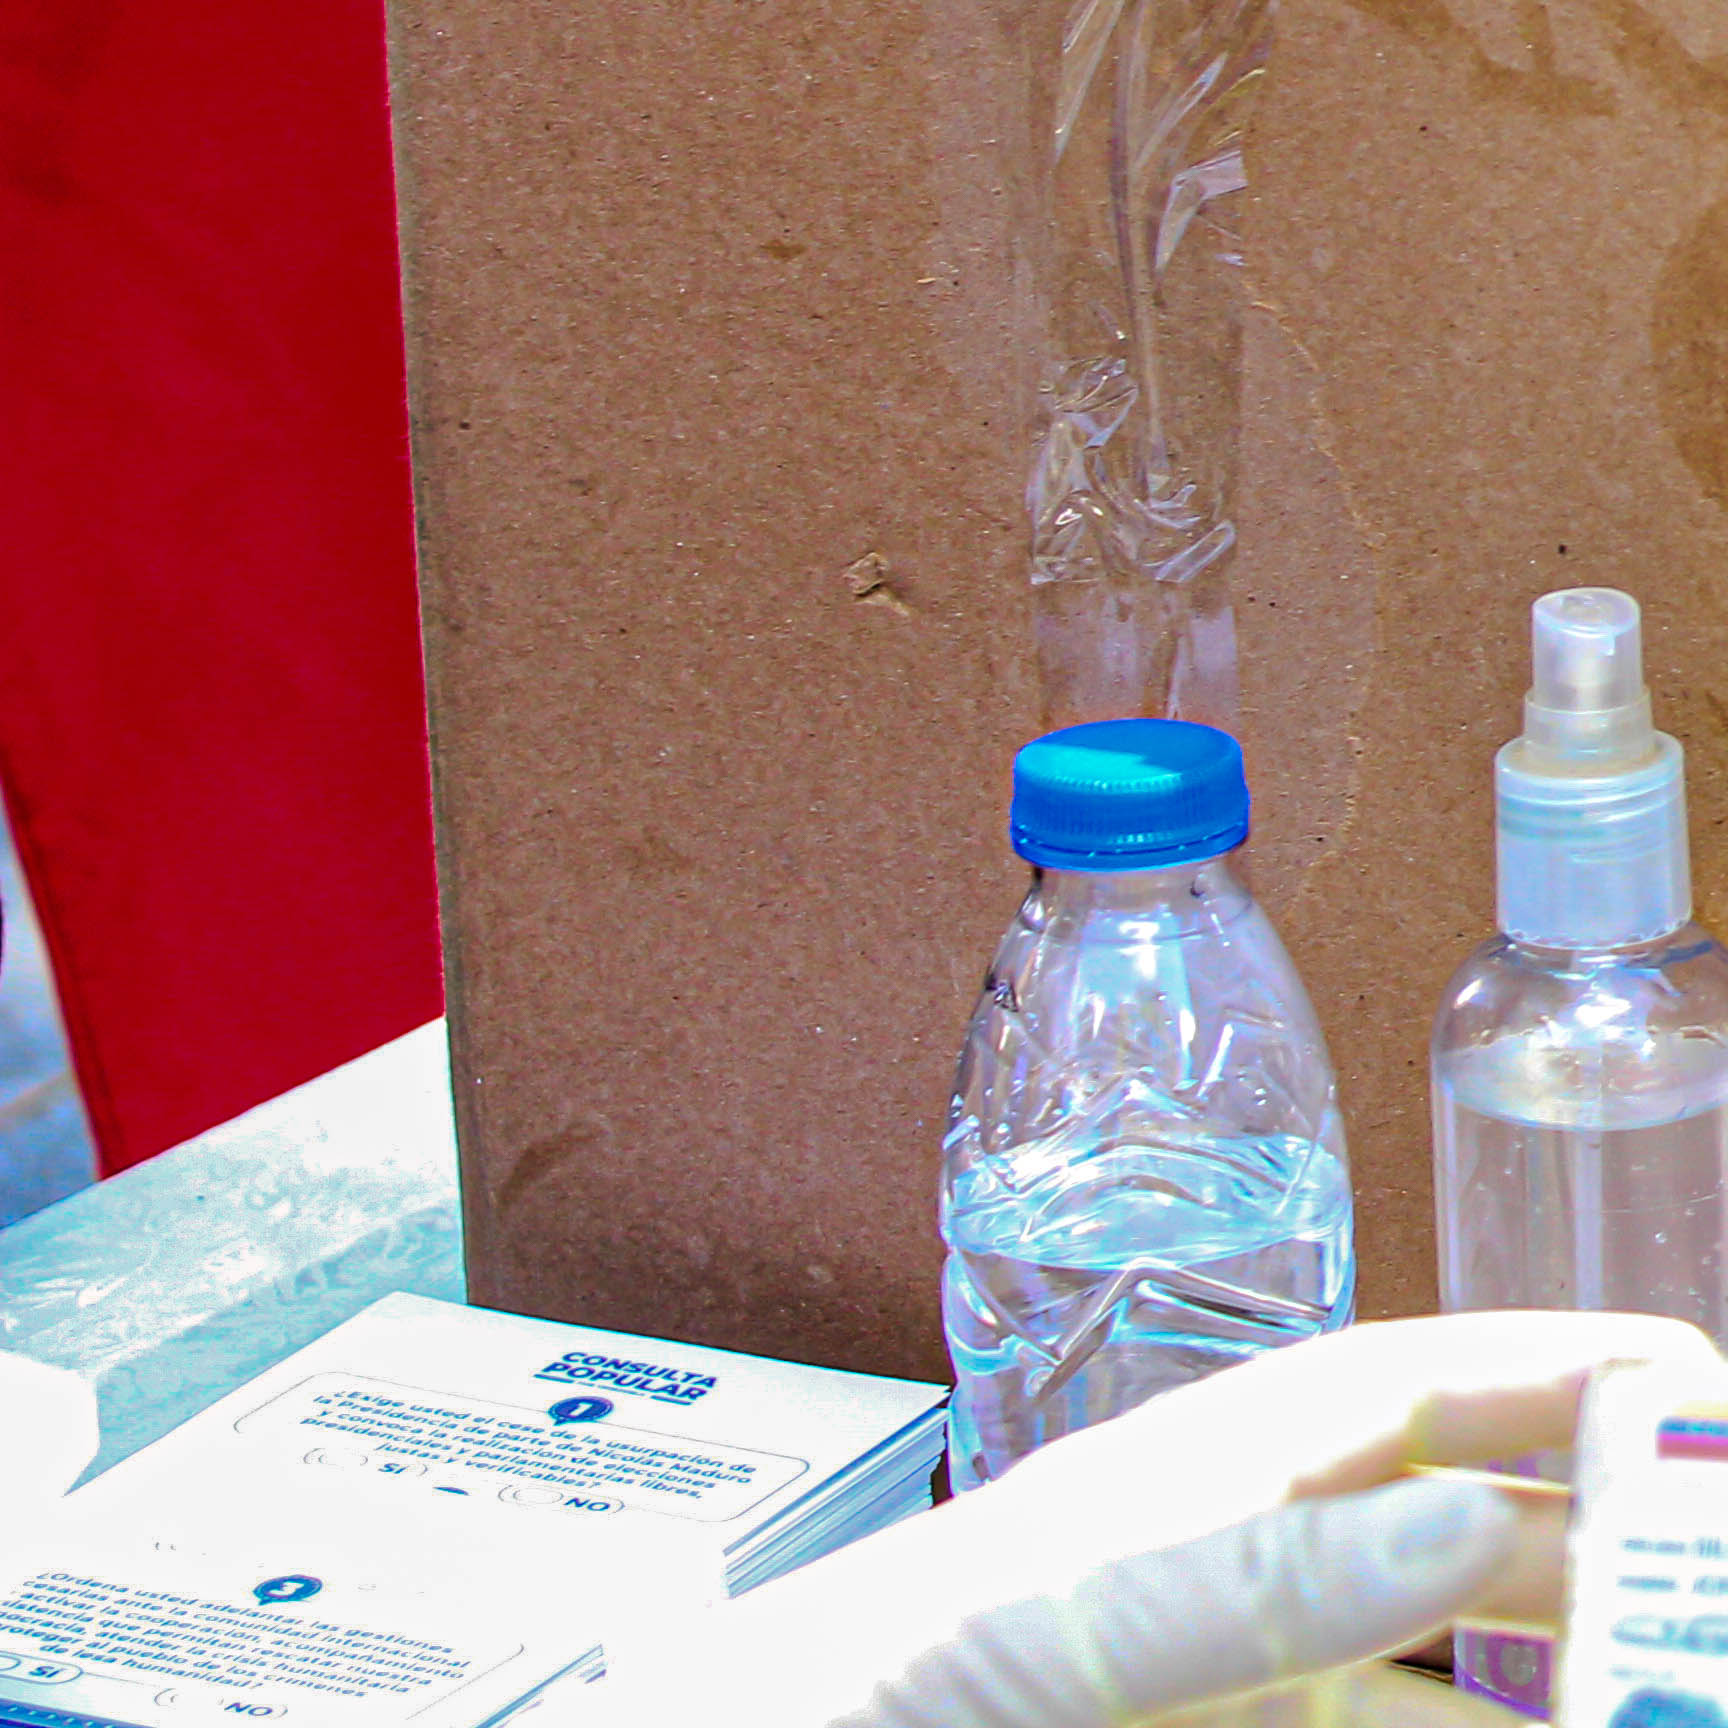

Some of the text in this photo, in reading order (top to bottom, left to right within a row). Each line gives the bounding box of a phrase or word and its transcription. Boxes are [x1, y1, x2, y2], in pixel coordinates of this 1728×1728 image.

[541, 1362, 707, 1400] POPULAR
[561, 1351, 717, 1388] CONSULTA
[313, 1395, 332, 1405] la
[464, 1425, 490, 1435] de
[492, 1431, 551, 1446] parte
[556, 1442, 583, 1453] de
[669, 1462, 752, 1484] Maduro
[334, 1391, 757, 1474] ¿Exige usted el cese de la usurpación de
[338, 1413, 424, 1433] convoca
[428, 1429, 448, 1439] la
[571, 1456, 598, 1467] de
[603, 1463, 716, 1489] elecciones
[373, 1441, 441, 1460] justas
[456, 1447, 473, 1455] y
[472, 1450, 635, 1485] parlamentarias
[564, 1497, 611, 1512] NO
[20, 1593, 97, 1611] activar
[100, 1605, 121, 1616] la
[134, 1590, 200, 1606] usted
[199, 1603, 304, 1626] adelantar
[310, 1620, 341, 1633] las
[344, 1629, 454, 1655] gestiones
[0, 1623, 85, 1645] roteger
[85, 1640, 112, 1650] al
[107, 1645, 189, 1665] pueblo
[193, 1660, 222, 1670] de
[226, 1665, 257, 1678] los
[39, 1644, 69, 1655] de
[72, 1648, 118, 1664] lesa
[98, 1619, 141, 1631] que
[142, 1628, 246, 1652] permitan
[251, 1647, 343, 1669] rescatar
[346, 1665, 433, 1686] nuestra
[114, 1598, 163, 1612] ante
[168, 1607, 189, 1617] la
[193, 1613, 320, 1640] comunidad
[321, 1633, 472, 1668] internacional
[95, 1631, 182, 1651] atender
[185, 1646, 207, 1656] la
[212, 1652, 267, 1668] crisis
[273, 1661, 410, 1694] humanitaria
[223, 1702, 273, 1717] NO
